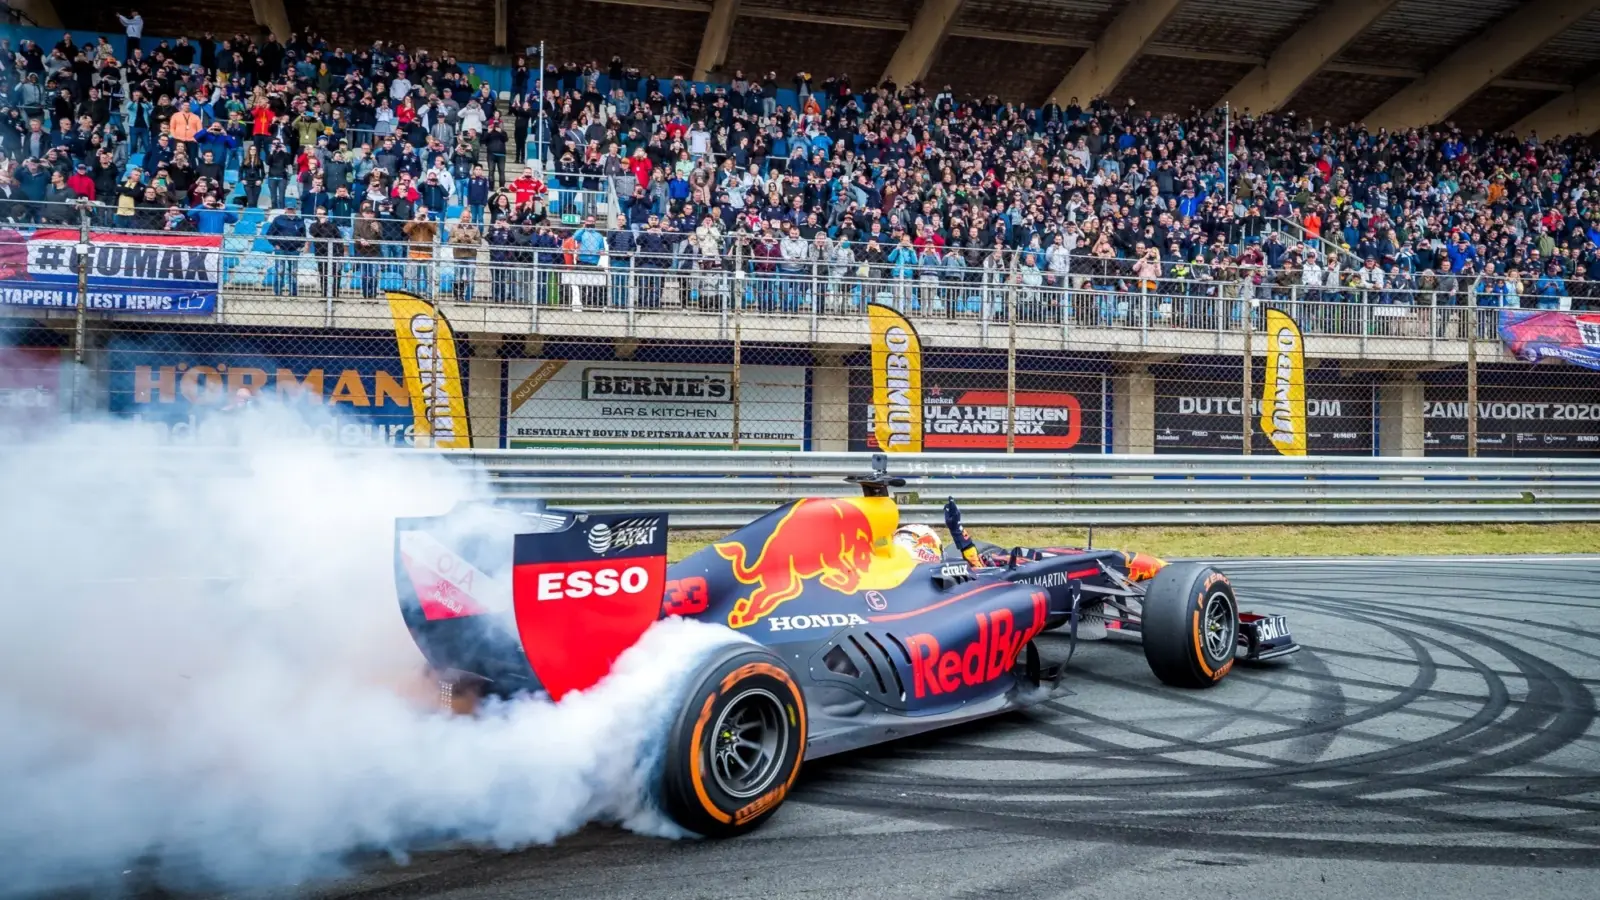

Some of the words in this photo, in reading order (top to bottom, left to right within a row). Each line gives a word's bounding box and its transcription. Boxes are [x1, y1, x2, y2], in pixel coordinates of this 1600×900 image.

[126, 294, 172, 310] NEWS
[134, 363, 411, 406] HÖRMAN
[516, 386, 530, 400] NU
[529, 363, 556, 387] OPEN
[593, 374, 726, 398] BERNIE'S
[885, 326, 911, 448] JUMBO
[1272, 327, 1296, 444] JUMBO
[602, 407, 632, 416] BAR
[637, 408, 647, 417] &
[652, 408, 717, 418] KITCHEN
[1553, 404, 1600, 420] 2020
[517, 428, 591, 438] RESTAURANT
[593, 430, 629, 439] BOVEN
[631, 430, 646, 439] DE
[647, 431, 706, 439] PITSTRAAT
[708, 432, 731, 440] VAN
[933, 420, 999, 433] GRAND
[614, 526, 658, 546] AT&T
[538, 566, 649, 601] ESSO
[1034, 571, 1068, 588] MARTIN
[663, 576, 709, 616] 33
[768, 613, 868, 631] HONDA
[1256, 618, 1279, 643] obil
